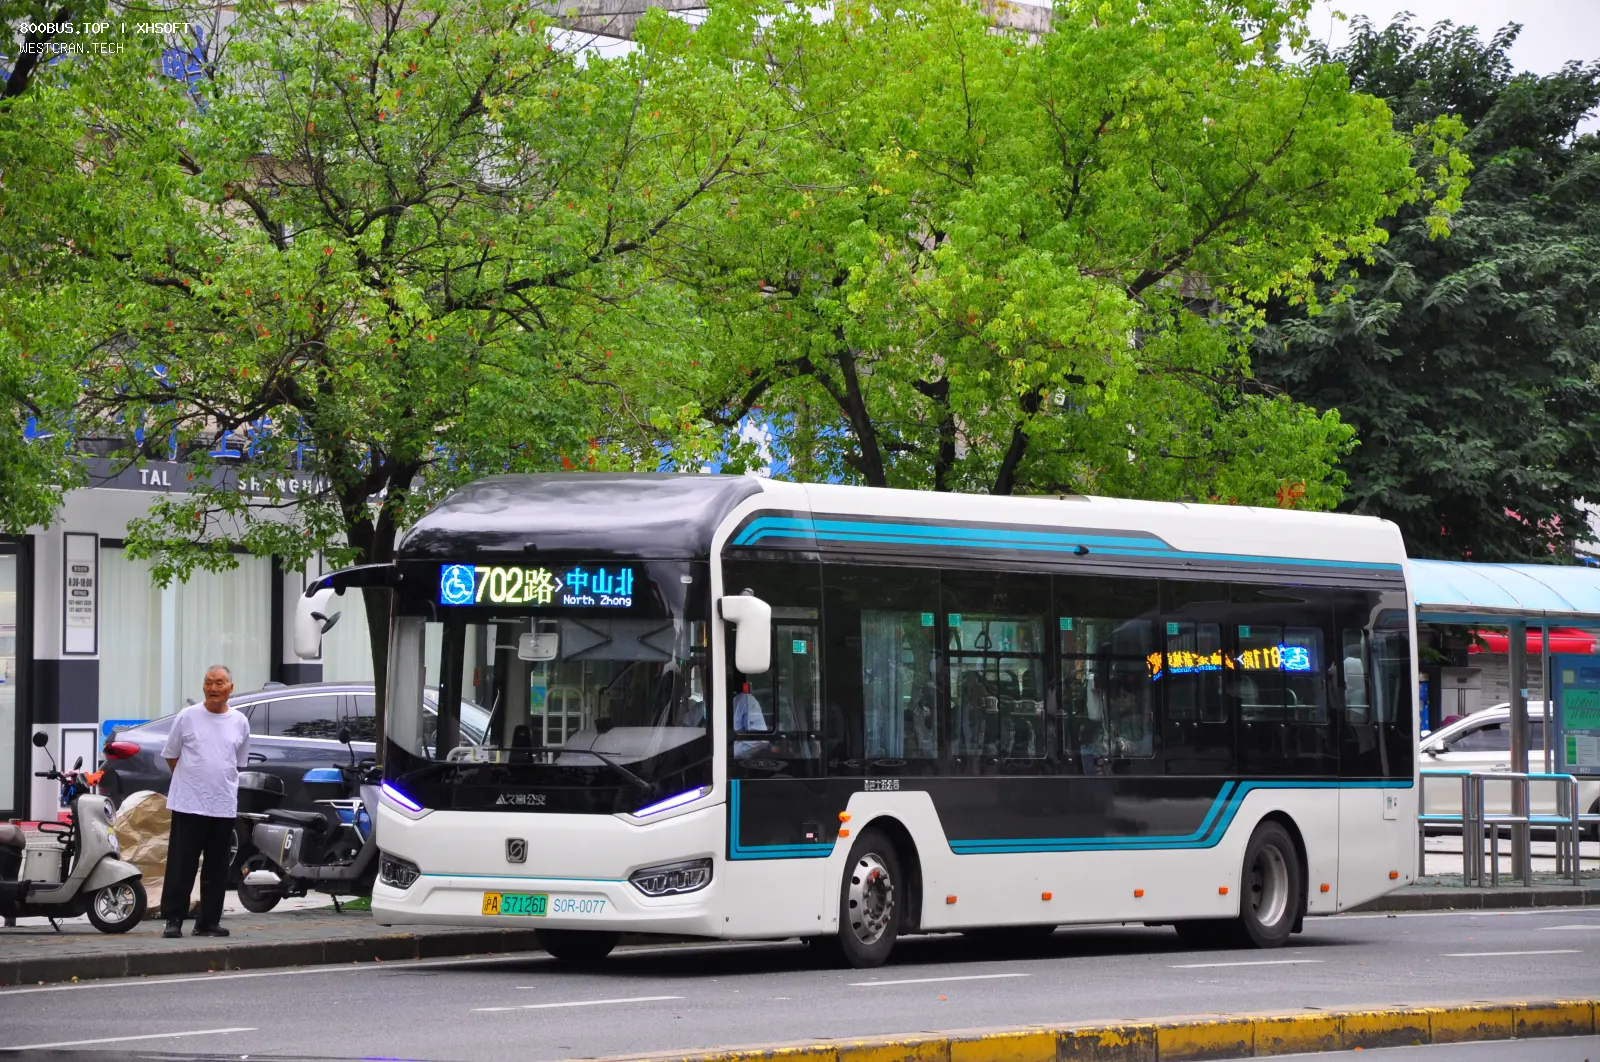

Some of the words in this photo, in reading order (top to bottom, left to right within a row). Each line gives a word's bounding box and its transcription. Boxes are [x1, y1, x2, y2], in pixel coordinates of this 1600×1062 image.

[139, 469, 171, 487] TAL
[475, 566, 554, 605] 702路
[566, 567, 633, 596] 中山北
[563, 594, 595, 606] North
[600, 594, 632, 607] Zhong
[284, 835, 293, 849] 6
[503, 896, 547, 913] 57126D
